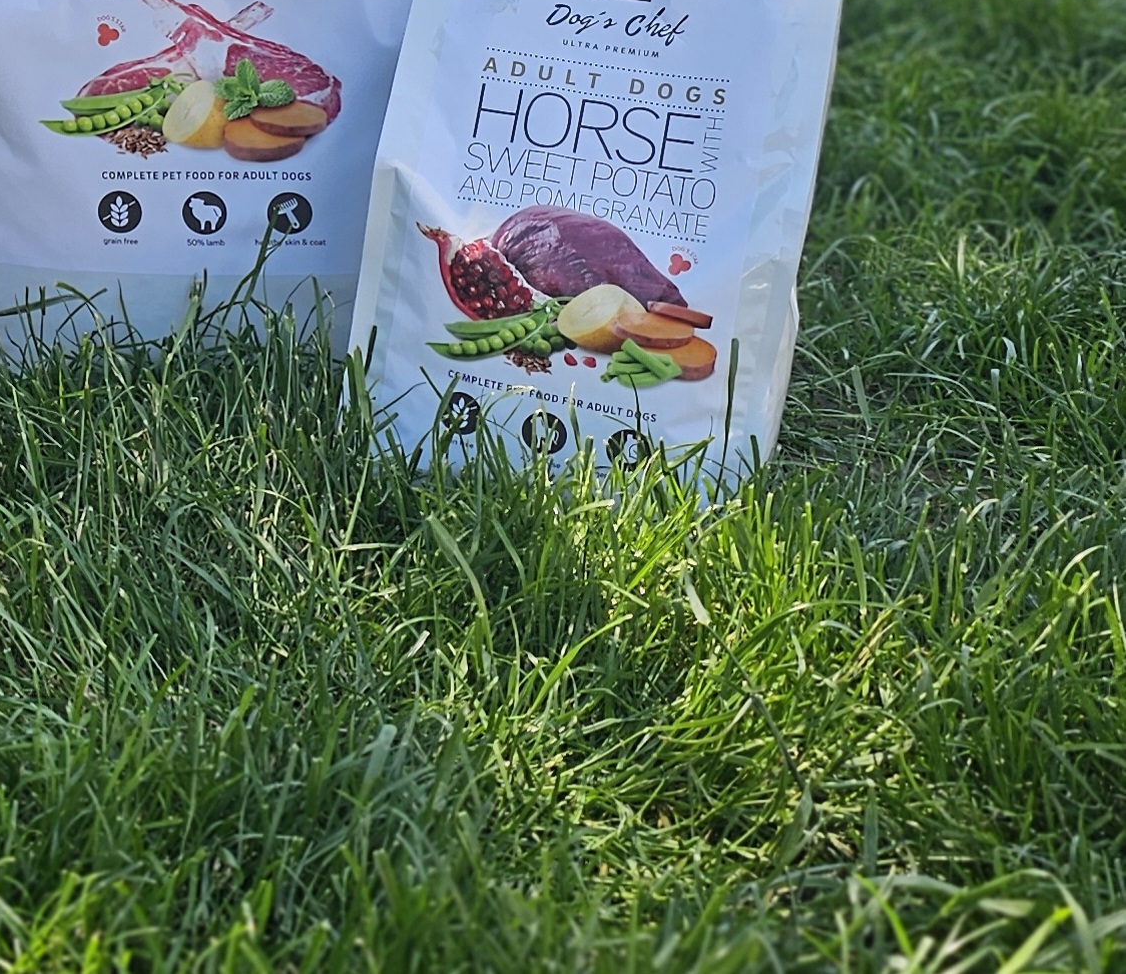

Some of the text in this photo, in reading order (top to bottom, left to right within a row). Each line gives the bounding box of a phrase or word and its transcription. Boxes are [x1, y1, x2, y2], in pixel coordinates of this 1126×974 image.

[624, 6, 689, 47] Chef
[562, 38, 660, 58] ULTRA PREMIUM
[482, 56, 727, 105] ADULT DOGS
[472, 83, 701, 173] HORSE
[699, 115, 724, 174] WITH
[102, 171, 312, 181] COMPLETE PET FOOD FOR ADULT DOGS
[458, 175, 513, 200] AND
[463, 141, 716, 210] SWEET POTATO
[103, 237, 138, 246] grain free
[186, 238, 225, 246] 50% lamb
[587, 402, 623, 416] ADULT
